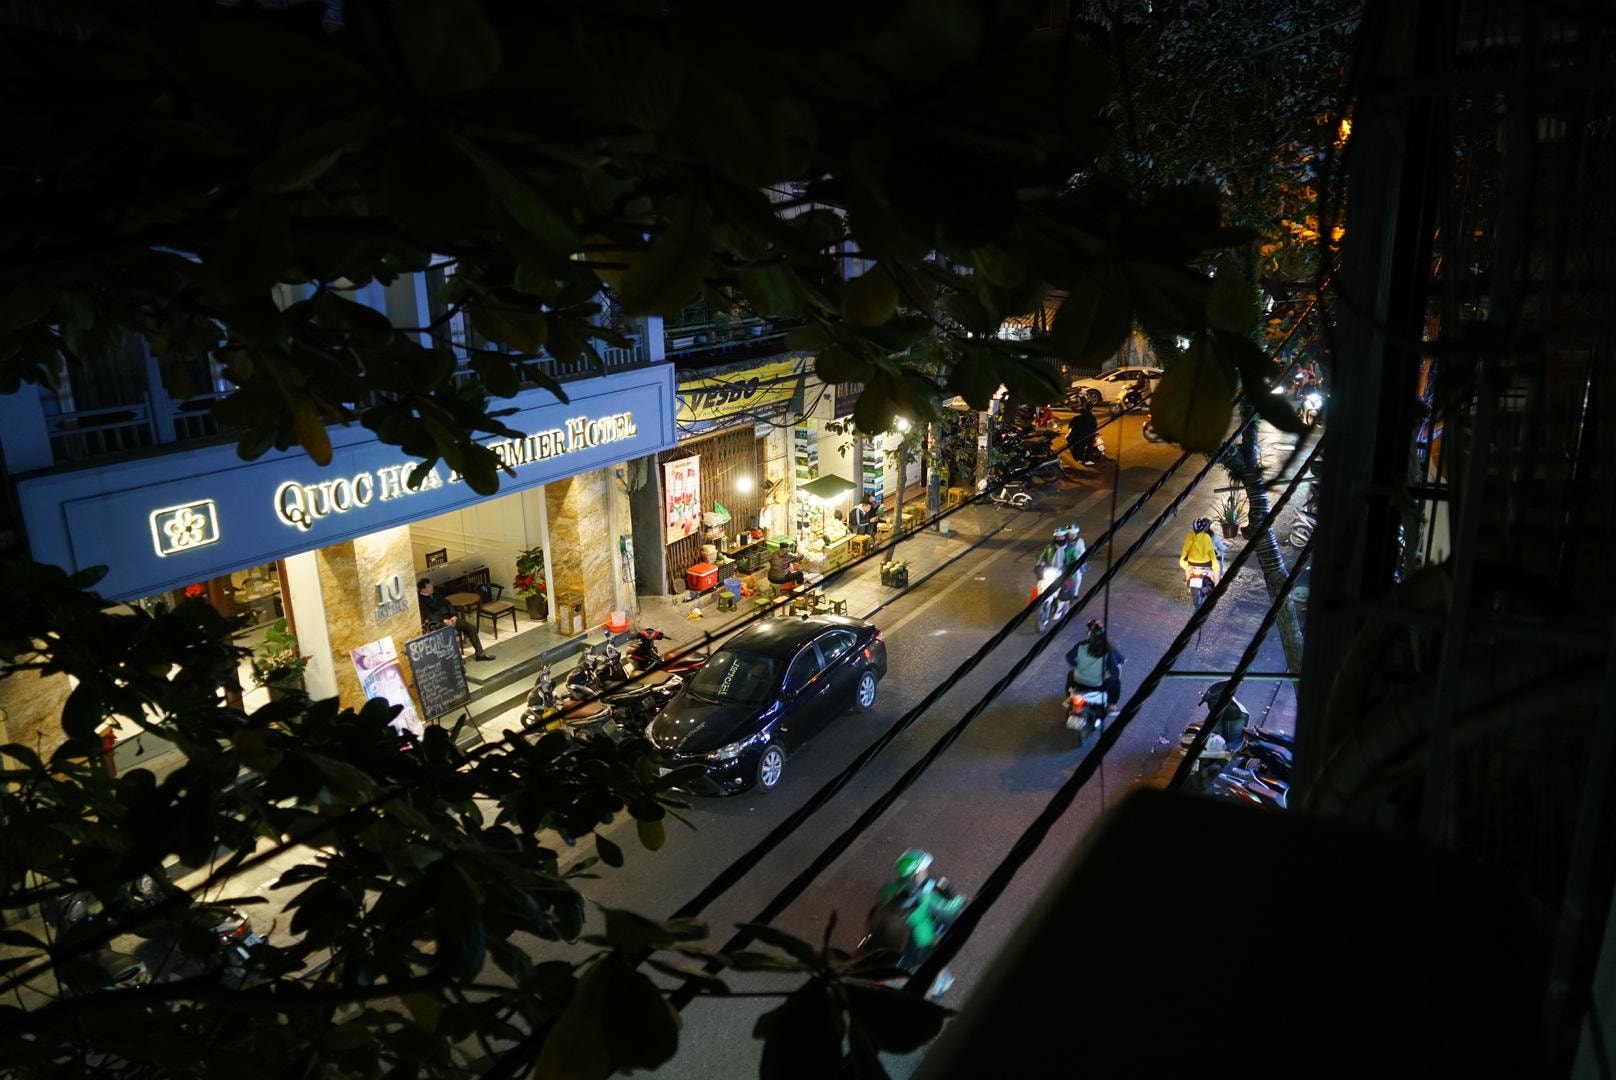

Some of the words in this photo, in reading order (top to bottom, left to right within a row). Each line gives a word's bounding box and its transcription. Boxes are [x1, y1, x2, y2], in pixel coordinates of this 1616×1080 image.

[274, 471, 374, 533] QUOC
[377, 461, 442, 502] HOA
[449, 428, 567, 485] EMIER
[565, 411, 638, 452] HOTEL
[375, 574, 405, 606] 10
